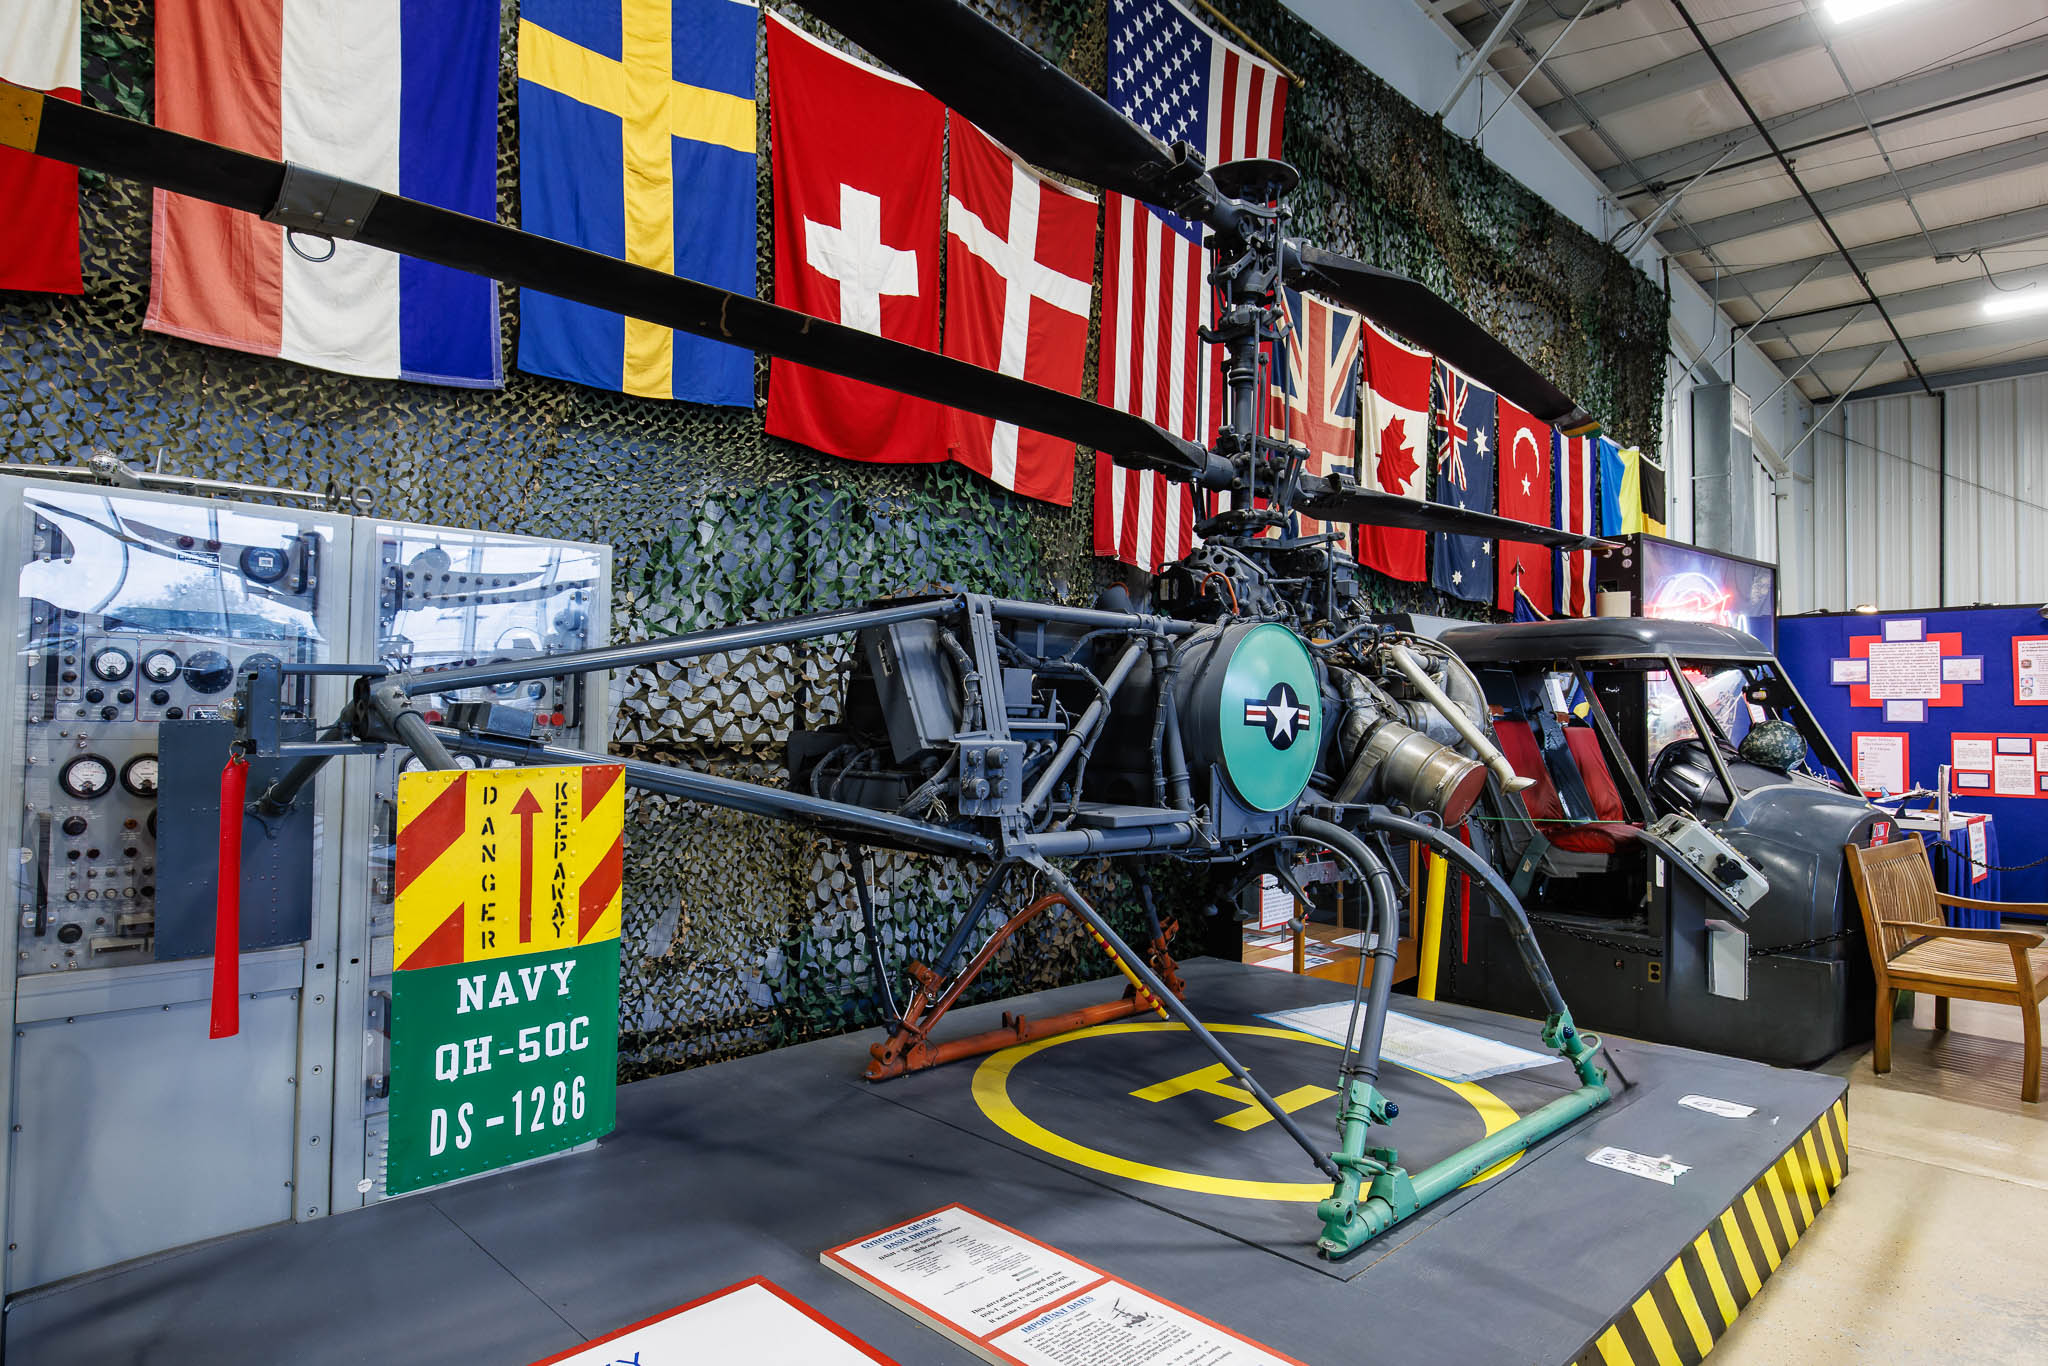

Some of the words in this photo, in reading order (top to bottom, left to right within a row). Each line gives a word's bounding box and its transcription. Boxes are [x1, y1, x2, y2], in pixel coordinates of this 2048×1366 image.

[481, 786, 498, 950] DANGER
[456, 959, 577, 1015] NAVY
[435, 1015, 590, 1083] QH-50C
[861, 1229, 908, 1249] GYRODYNE
[883, 1238, 909, 1250] DASH
[909, 1226, 939, 1240] DRONE
[1020, 1307, 1069, 1333] IMPORTANT
[1067, 1295, 1096, 1311] DATES
